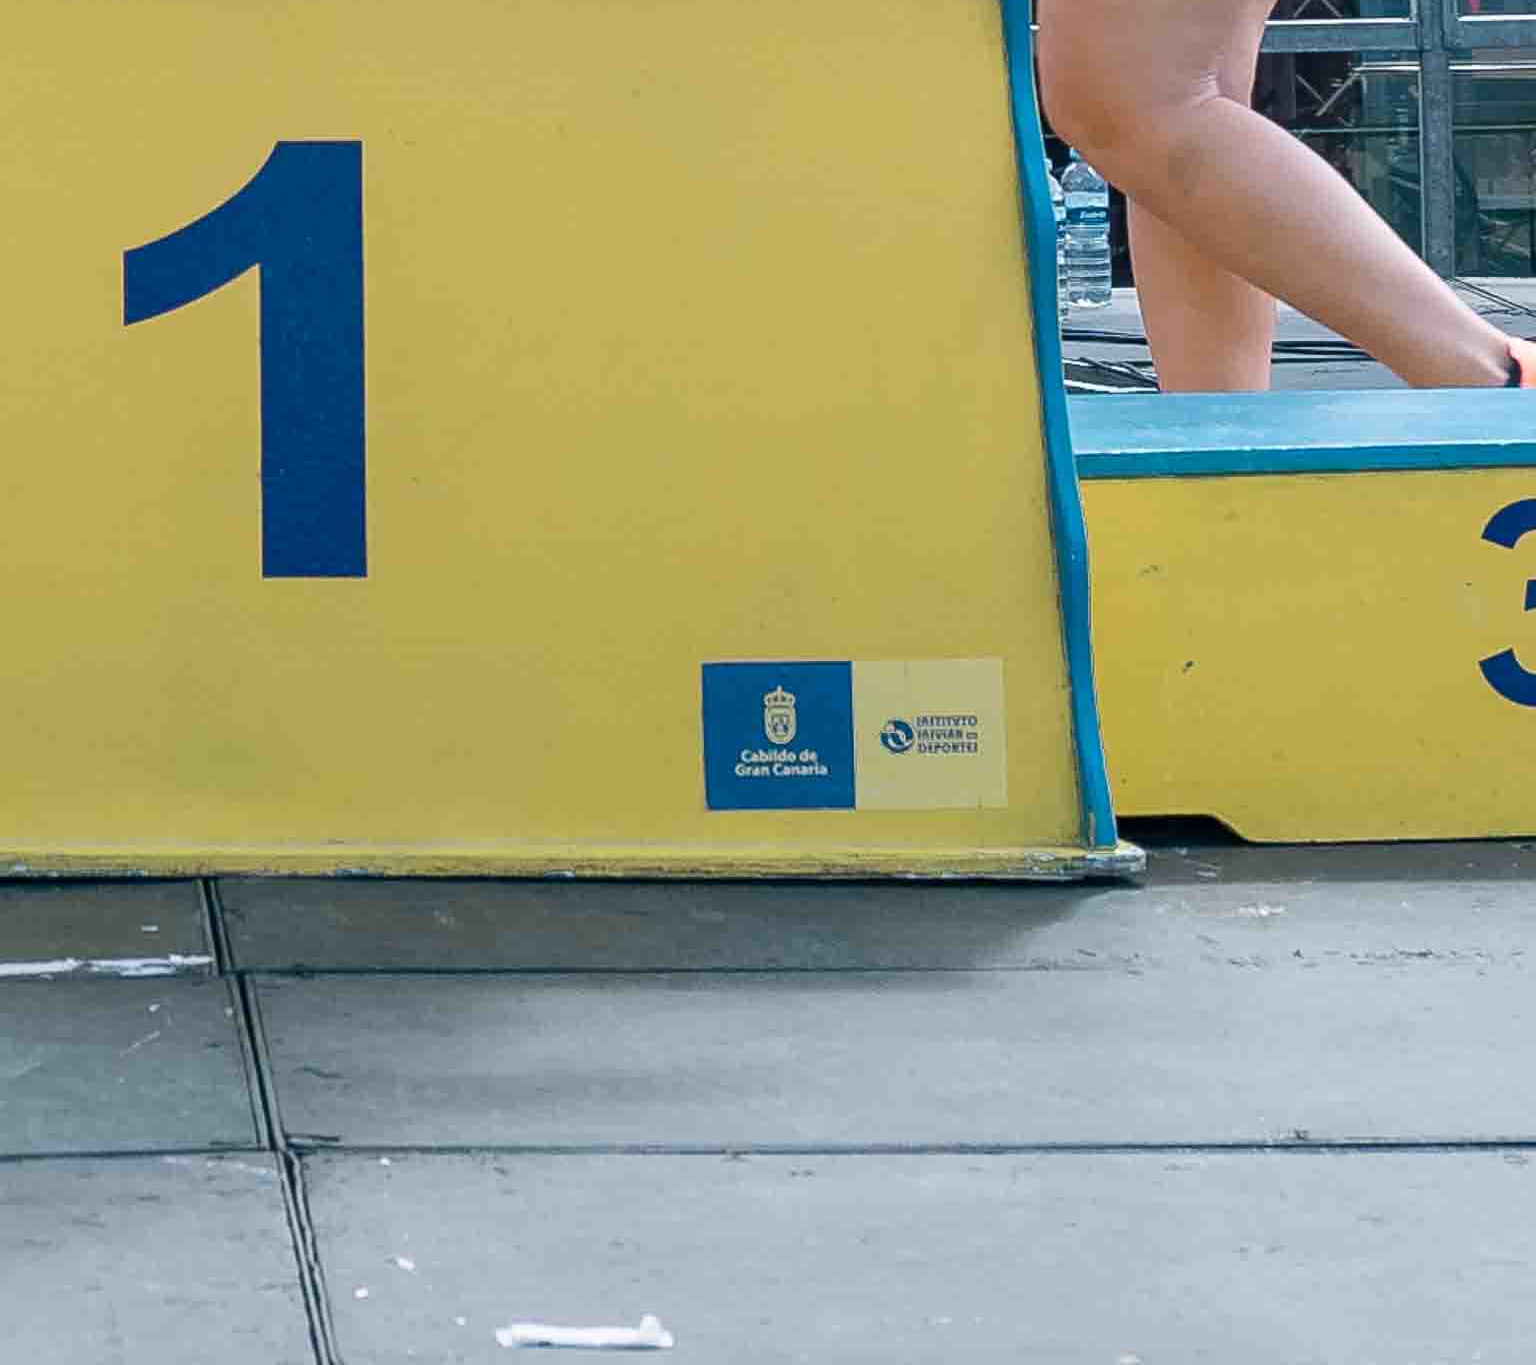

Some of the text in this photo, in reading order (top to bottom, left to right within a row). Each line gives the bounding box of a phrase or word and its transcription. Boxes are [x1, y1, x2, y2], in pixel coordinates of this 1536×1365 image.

[122, 139, 368, 578] 1
[740, 748, 818, 763] Cabildo de
[734, 761, 828, 777] Gran Canaria
